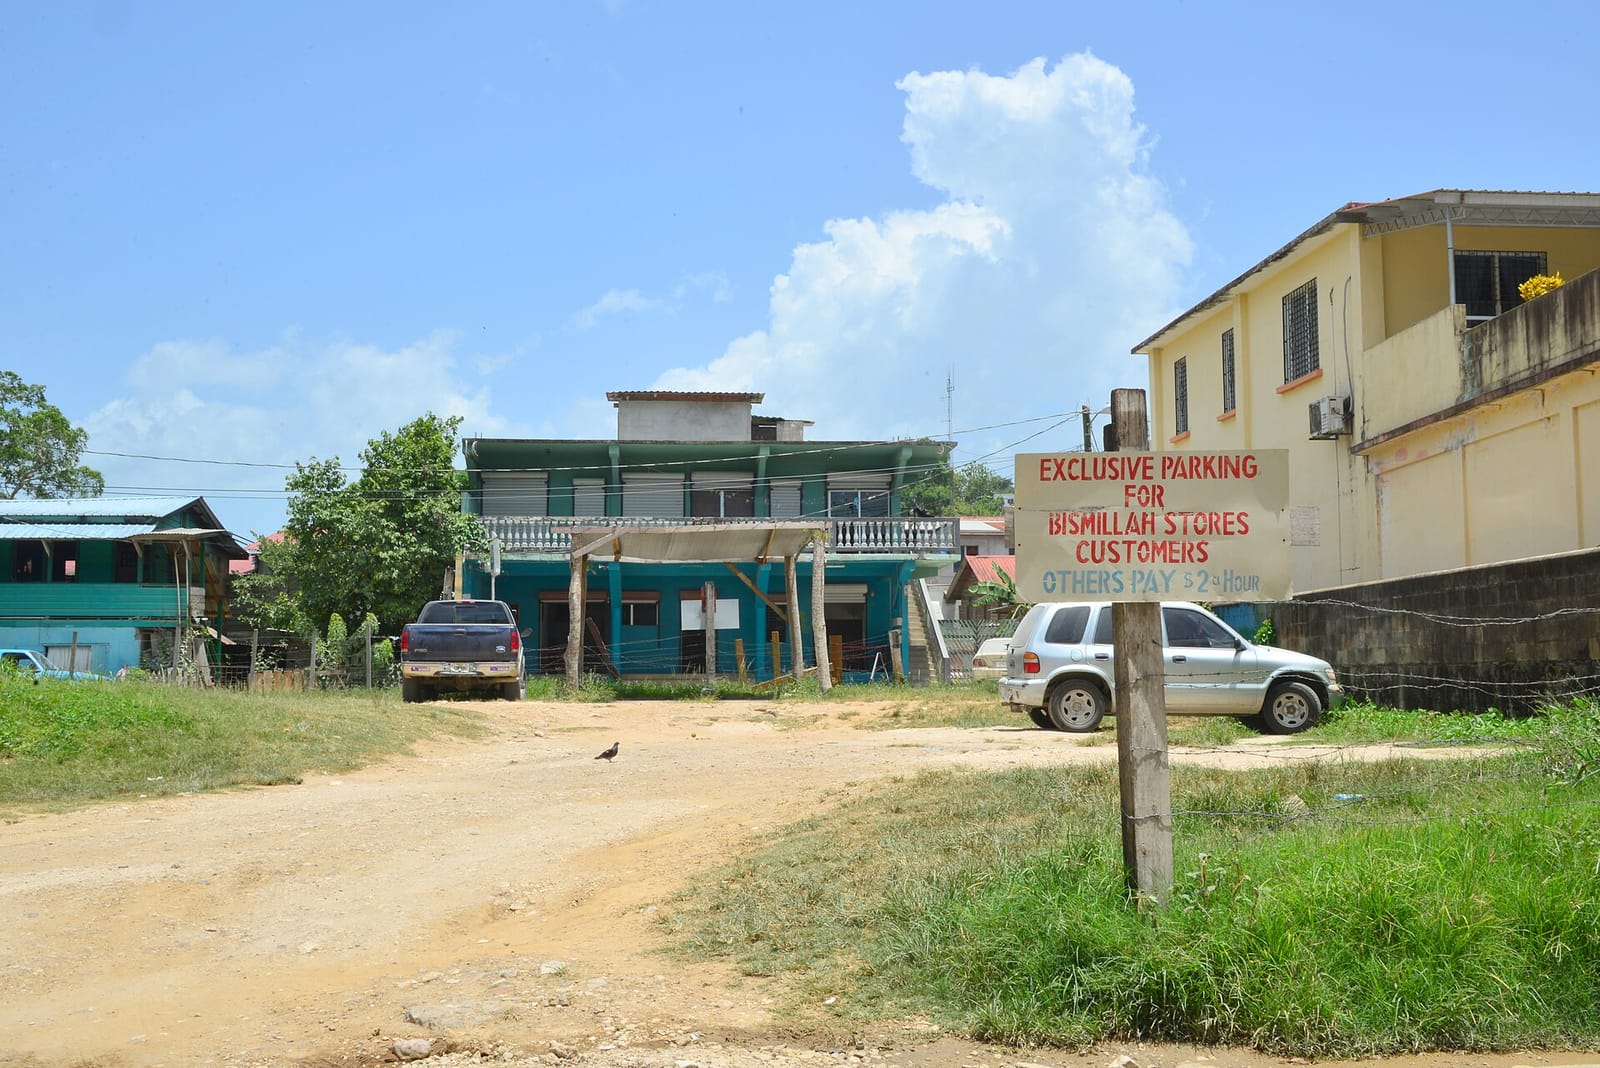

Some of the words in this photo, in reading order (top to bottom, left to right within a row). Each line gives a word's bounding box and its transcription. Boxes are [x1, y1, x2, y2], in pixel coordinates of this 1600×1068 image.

[1040, 456, 1154, 481] EXCLUSIVE
[1161, 455, 1258, 480] PARKING
[1124, 484, 1165, 508] FOR
[1049, 511, 1155, 536] BISMILLAH
[1164, 511, 1249, 536] STORES
[1076, 540, 1209, 564] CUSTOMERS
[1042, 570, 1124, 594] OTHERS
[1130, 569, 1176, 593] PAY
